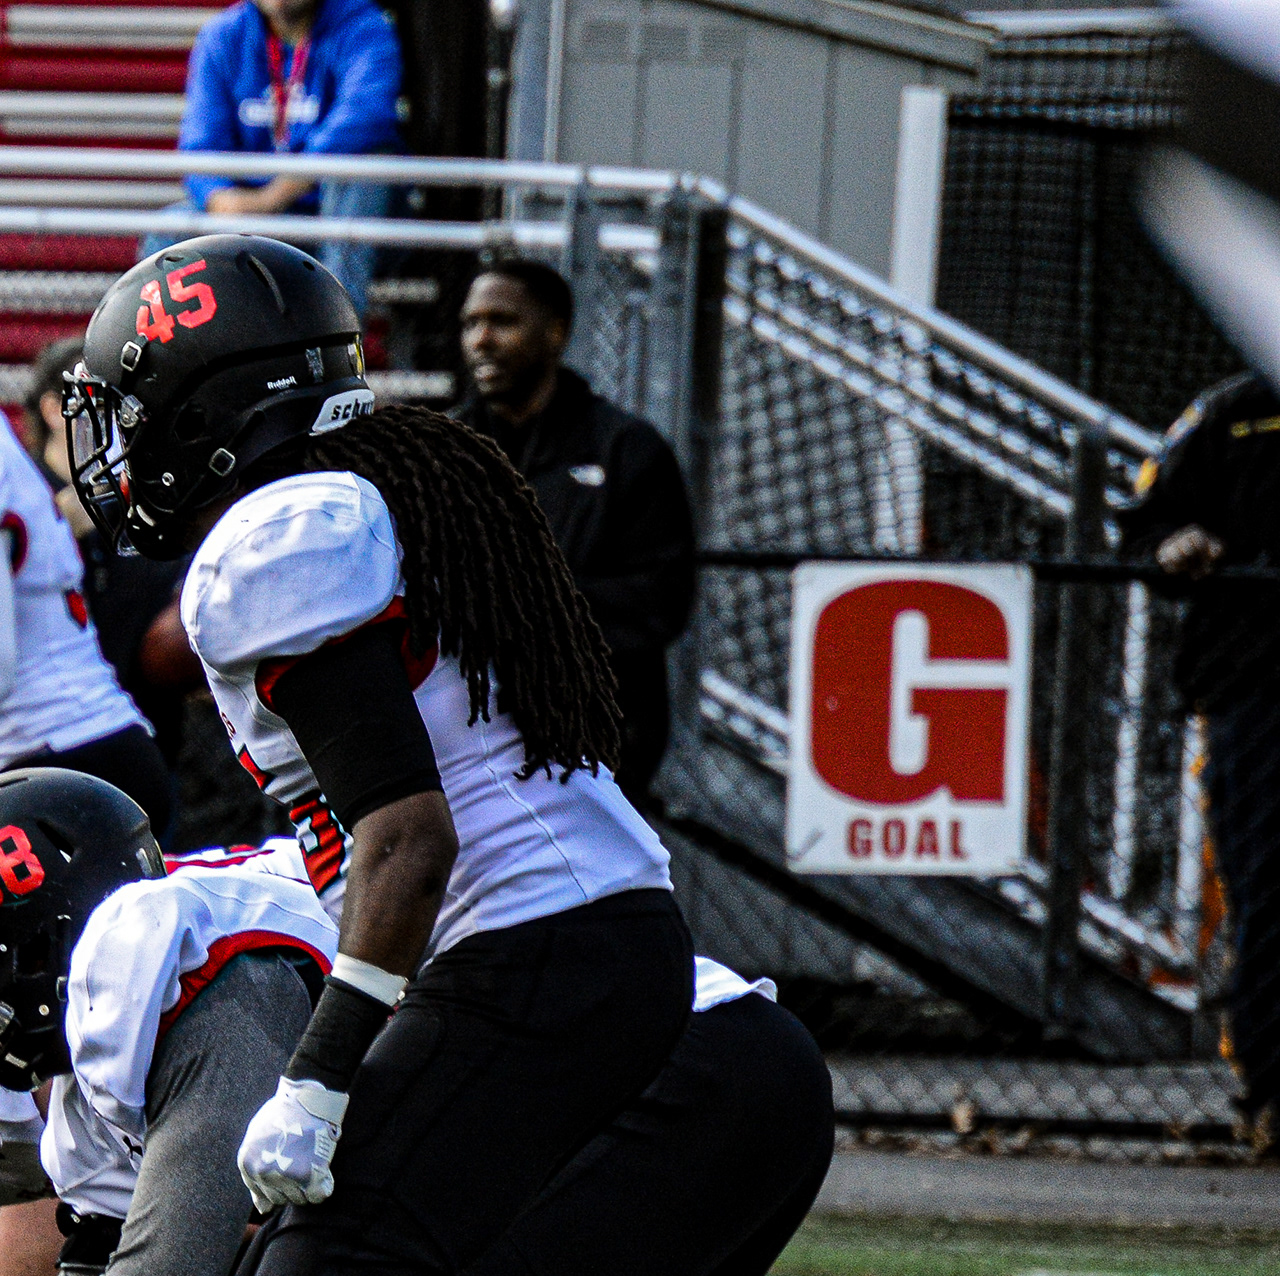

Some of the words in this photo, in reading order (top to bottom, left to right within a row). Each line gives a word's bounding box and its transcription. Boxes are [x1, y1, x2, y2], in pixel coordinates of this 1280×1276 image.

[136, 259, 217, 343] 45
[811, 579, 1010, 804] G
[846, 817, 969, 859] GOAL
